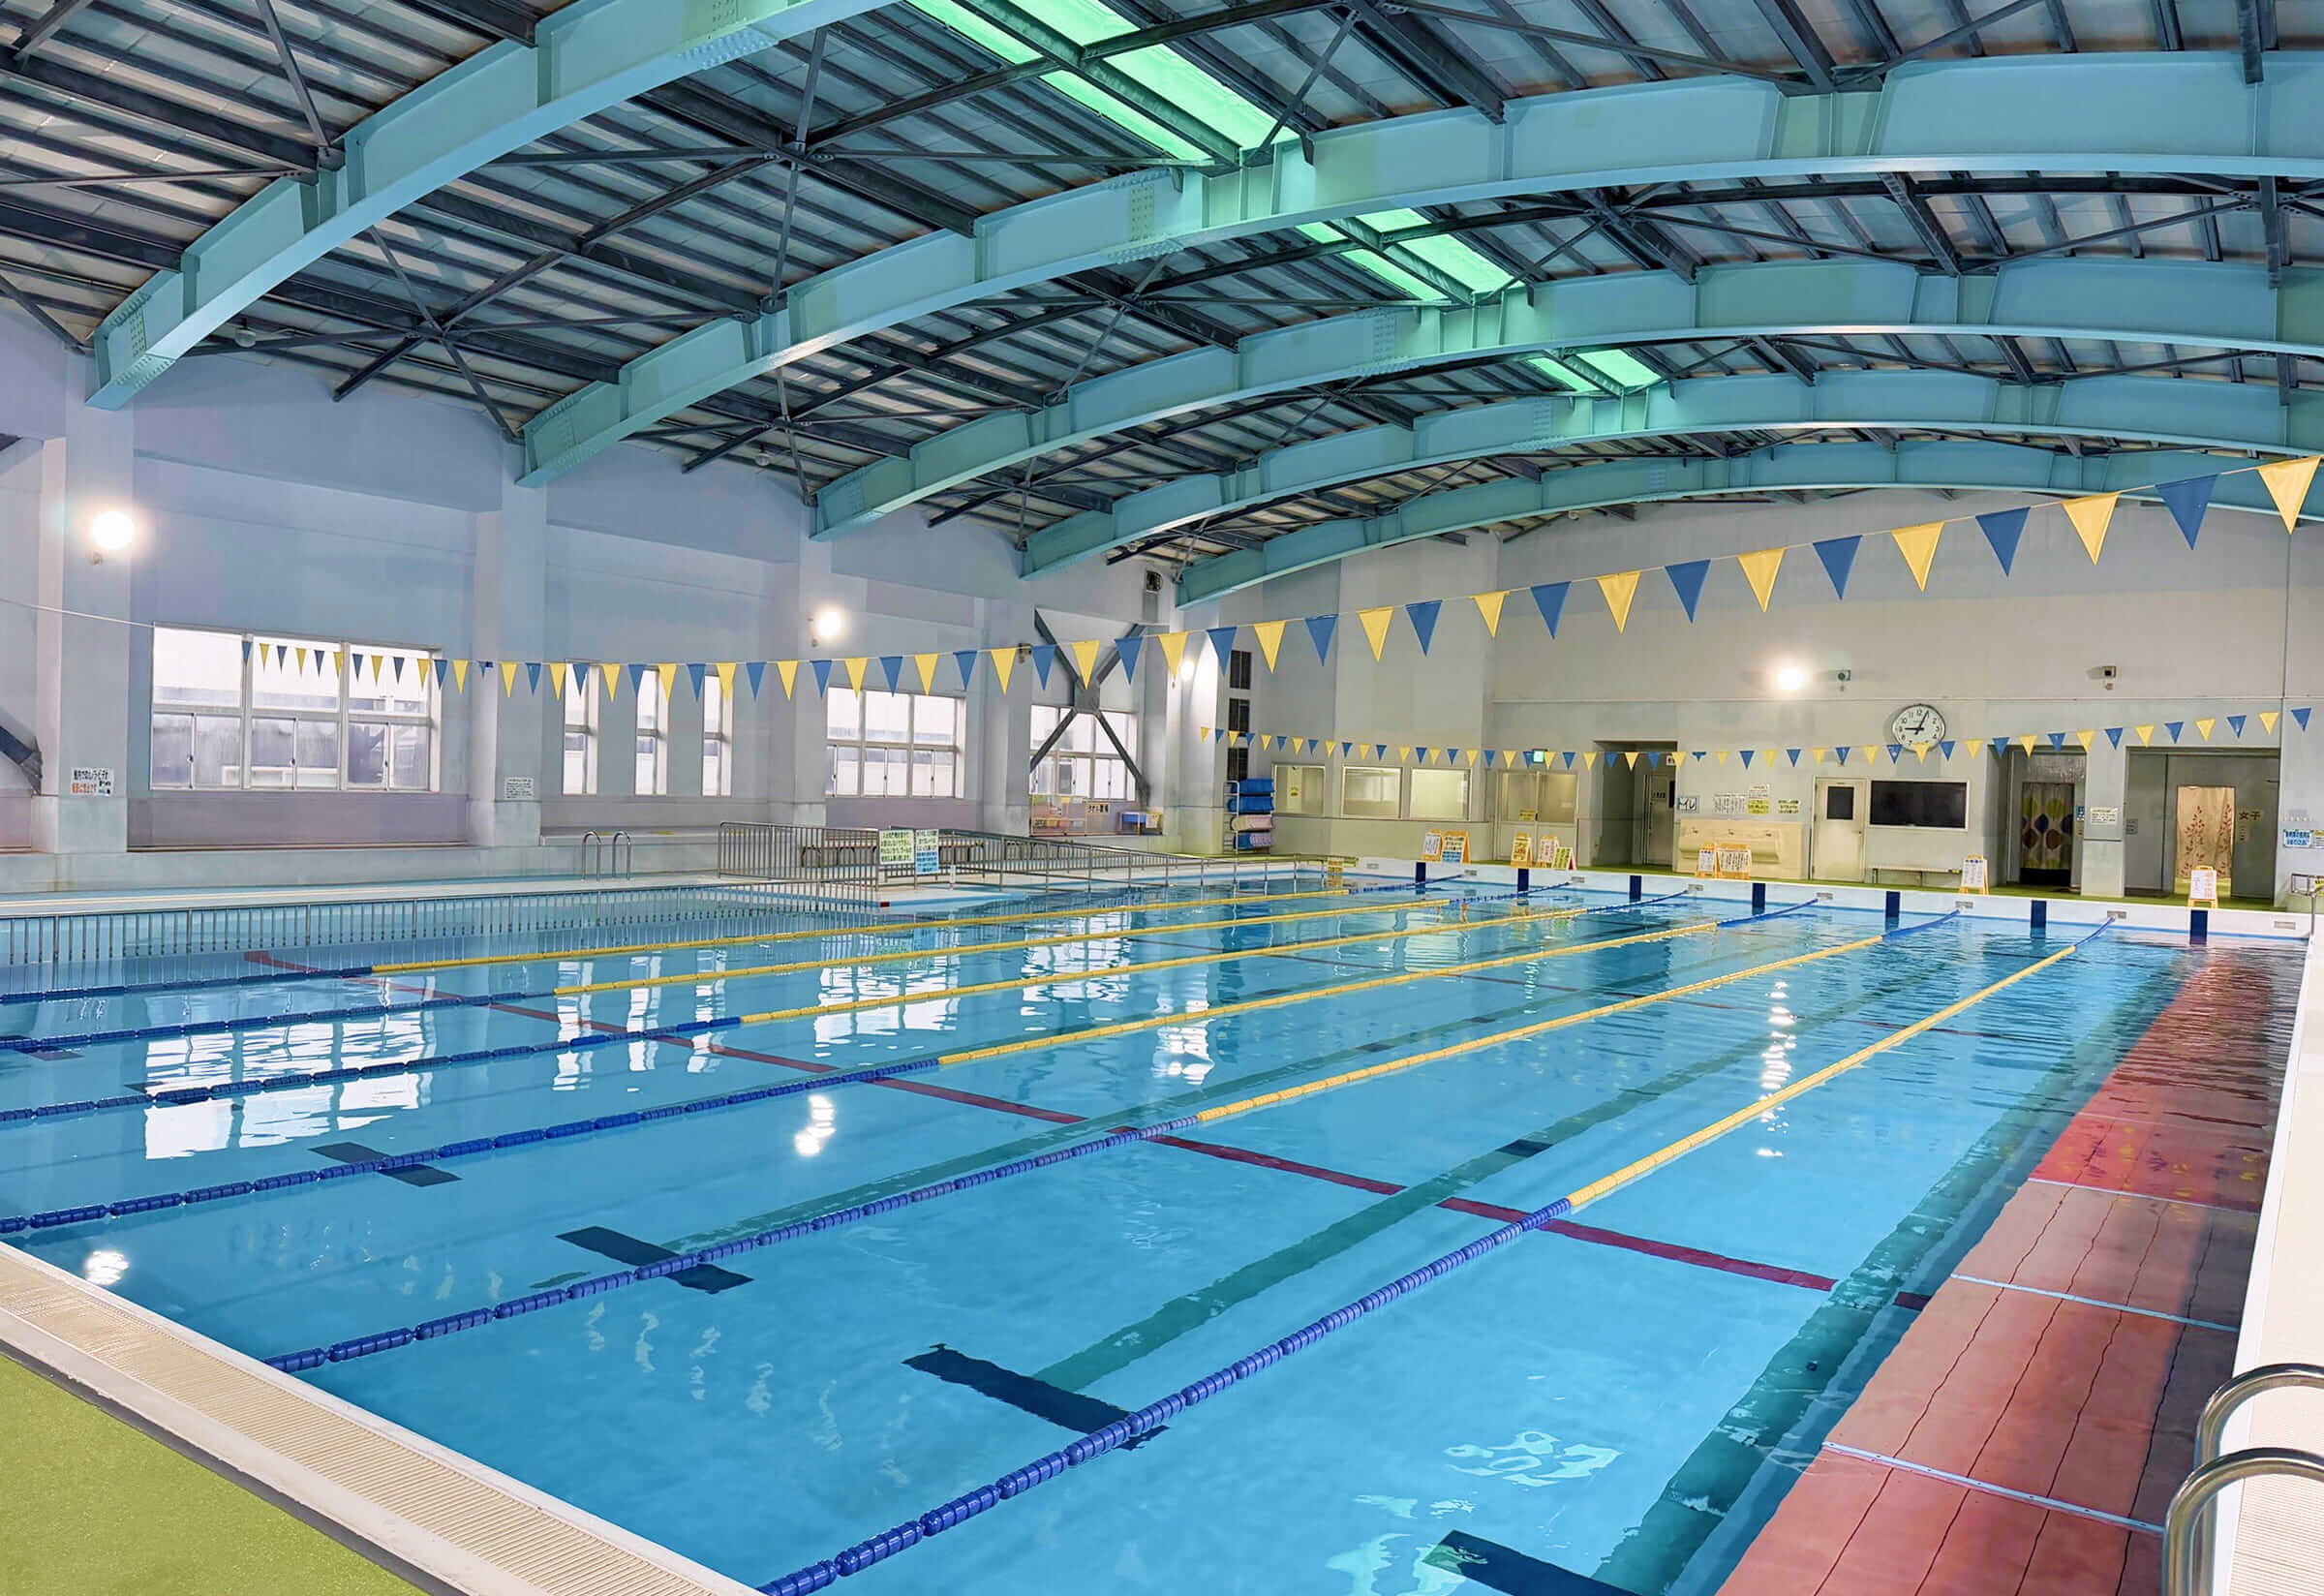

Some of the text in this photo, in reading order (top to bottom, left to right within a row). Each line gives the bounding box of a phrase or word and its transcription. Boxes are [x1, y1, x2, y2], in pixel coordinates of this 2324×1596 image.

[1677, 798, 1695, 811] トイレ
[2238, 812, 2261, 820] 女子
